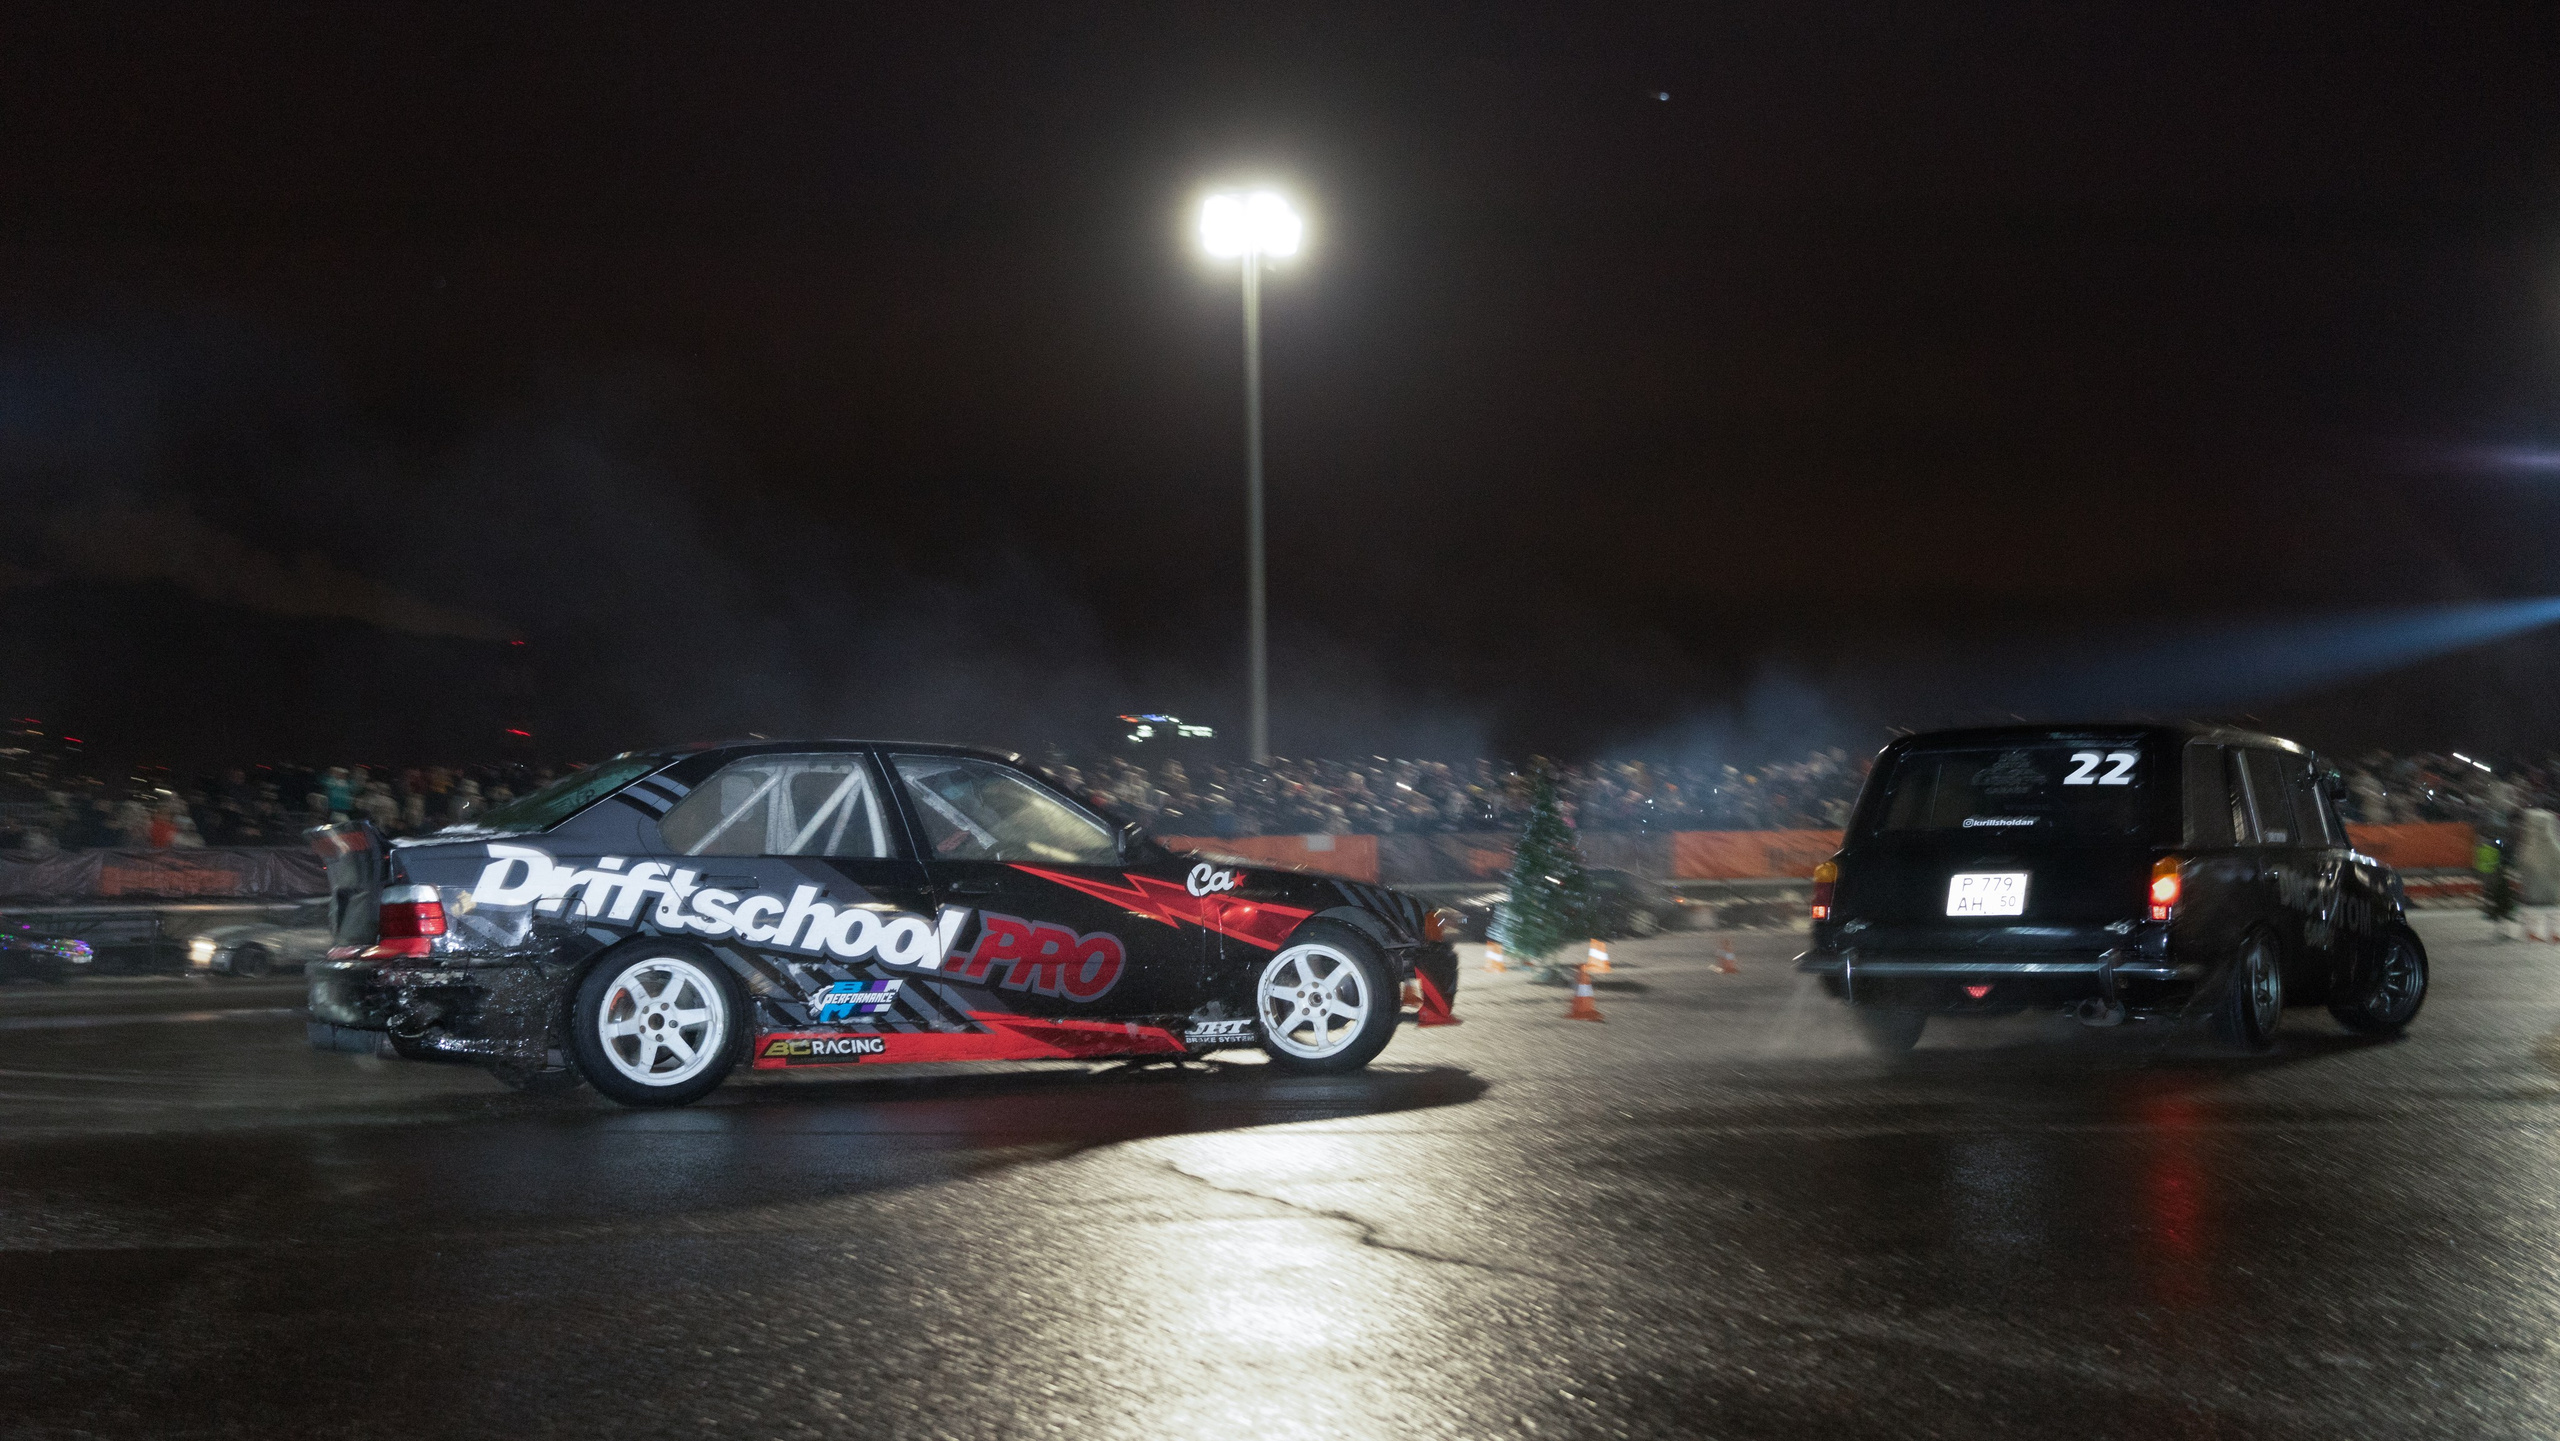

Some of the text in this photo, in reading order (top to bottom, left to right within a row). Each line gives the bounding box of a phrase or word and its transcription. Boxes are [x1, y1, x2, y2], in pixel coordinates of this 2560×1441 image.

[2062, 751, 2137, 786] 22
[1982, 876, 2013, 892] 779
[2000, 895, 2017, 907] 50
[822, 991, 896, 1009] PERFORMANCE
[764, 1038, 885, 1057] BC RACING
[1218, 1035, 1255, 1043] SYSTEM
